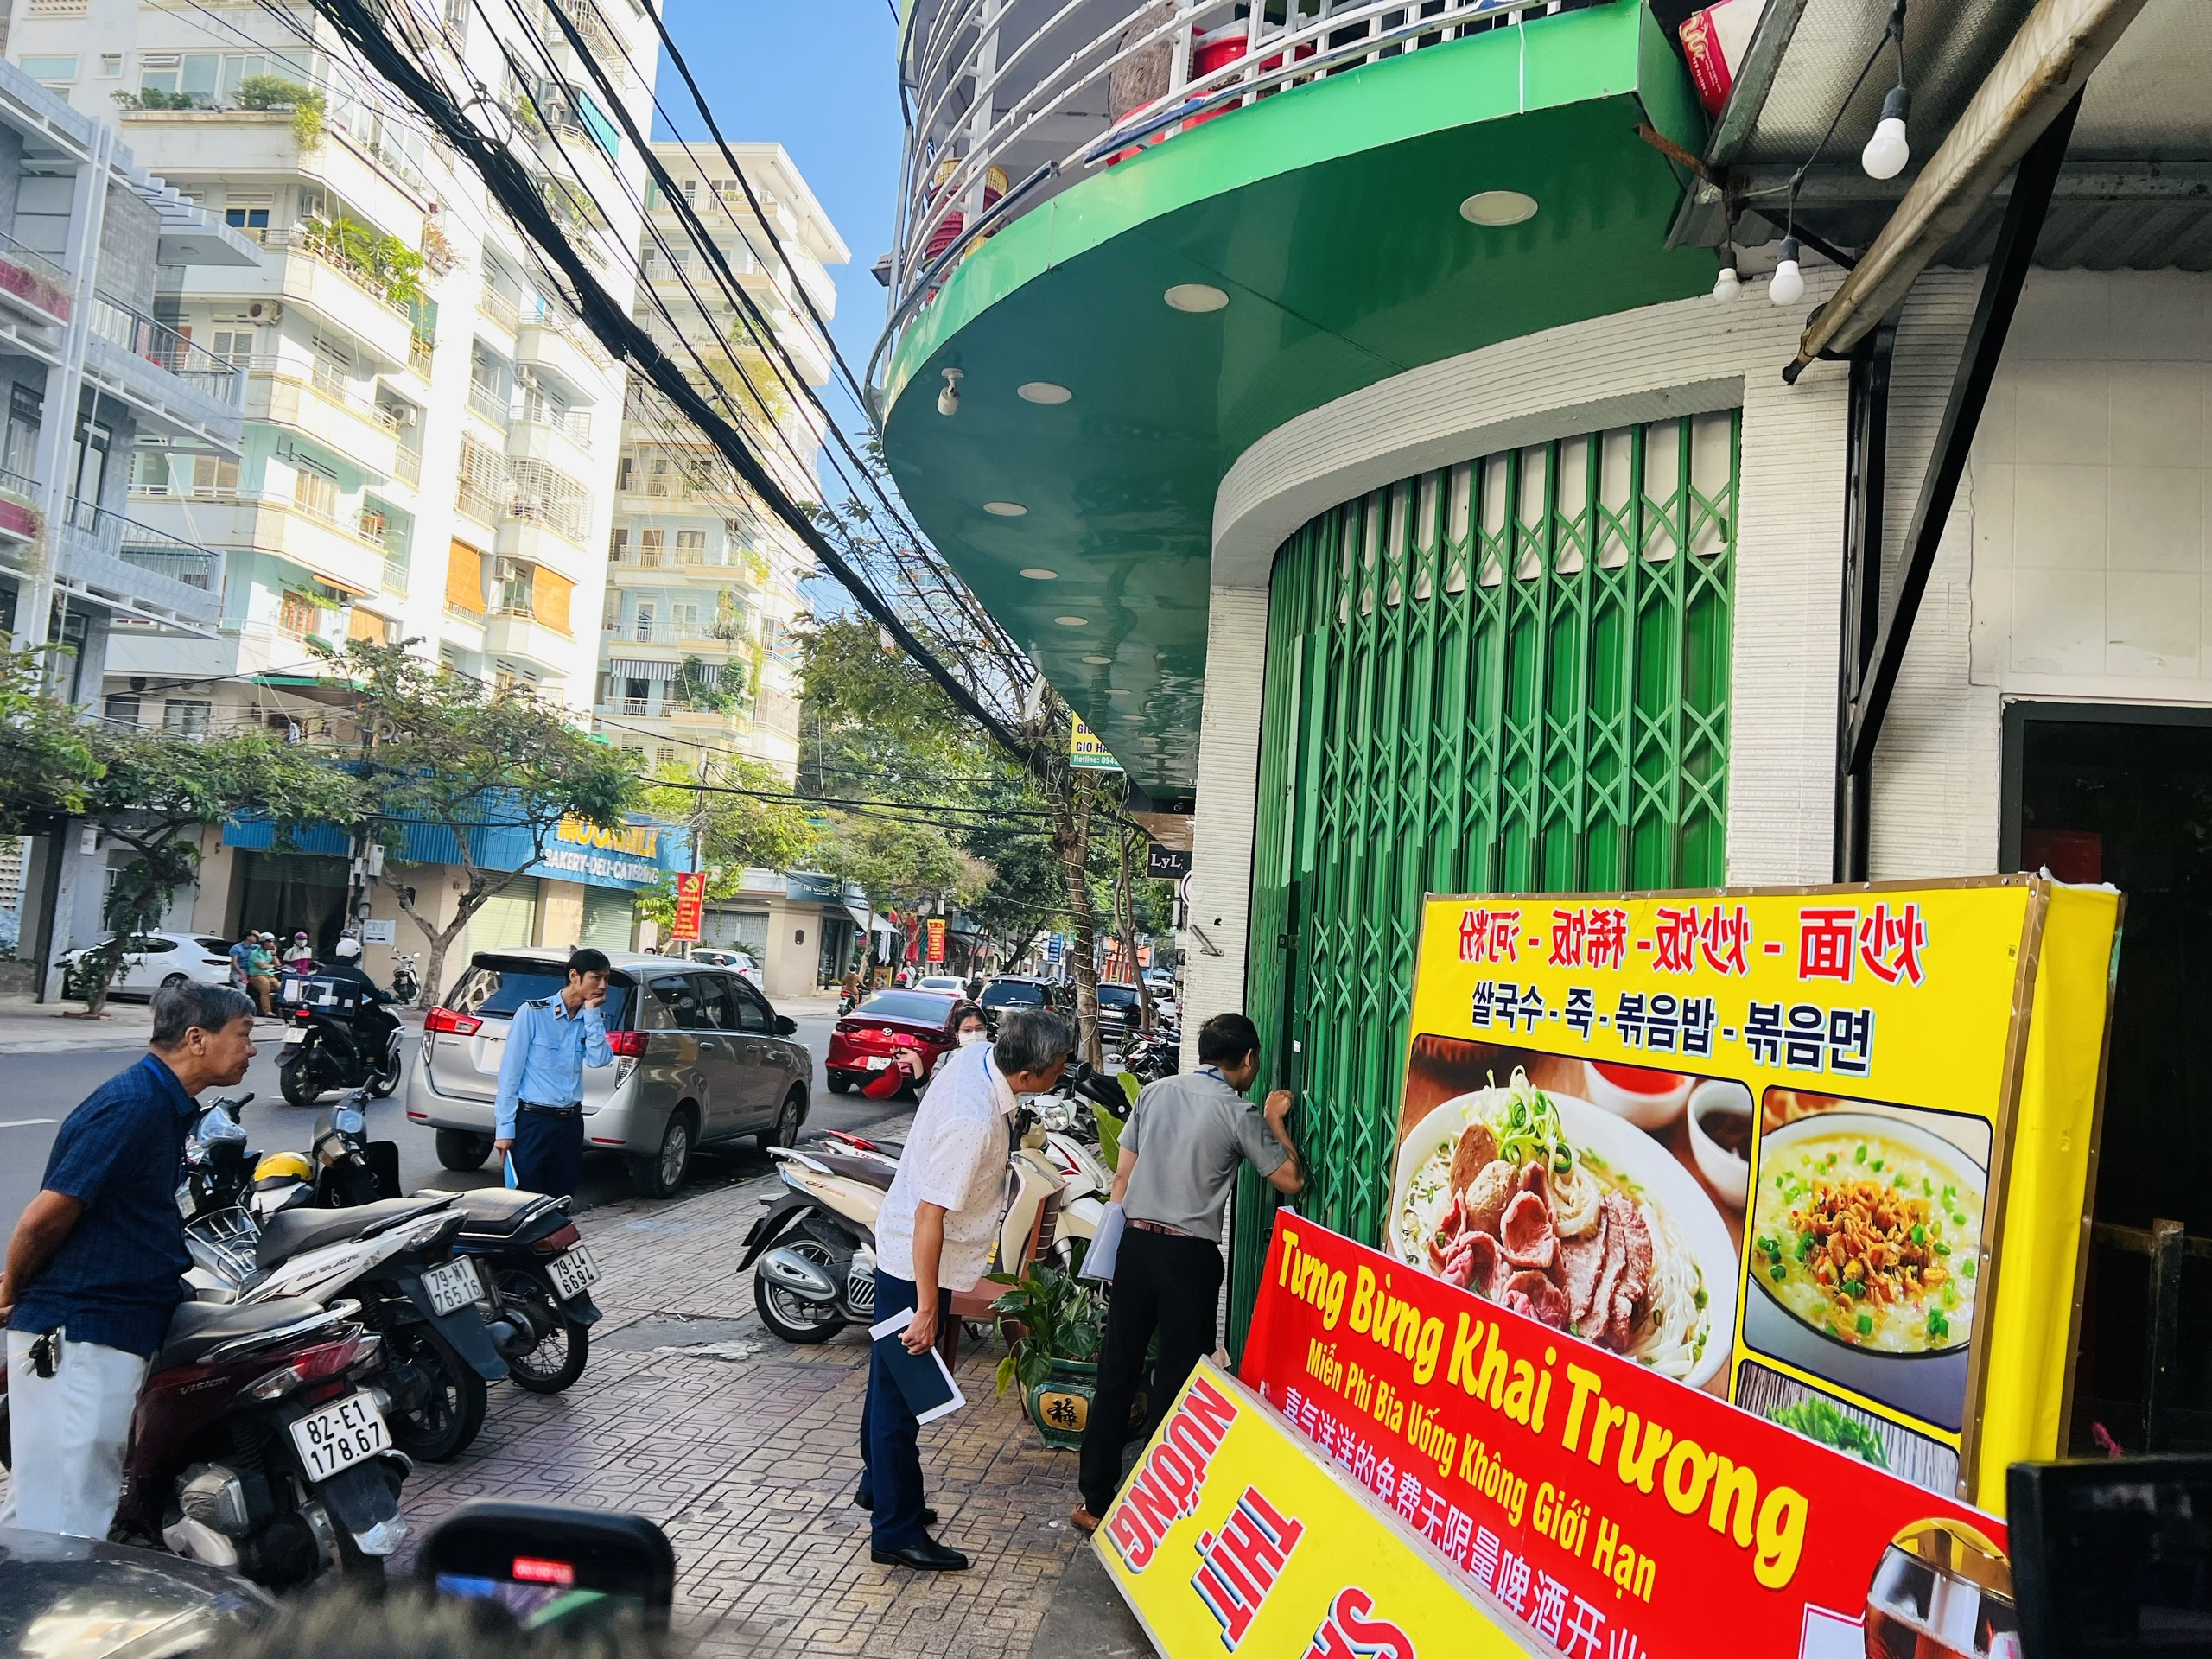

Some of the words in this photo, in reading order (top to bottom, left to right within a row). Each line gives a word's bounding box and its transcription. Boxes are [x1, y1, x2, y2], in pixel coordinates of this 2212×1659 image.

[1073, 754, 1100, 765] Hotline:
[1150, 853, 1184, 870] LyL
[1471, 982, 1544, 1032] 쌀국수
[1565, 988, 1593, 1039] 죽
[1615, 992, 1716, 1055] 볶음밥
[1744, 1001, 1872, 1073] 볶음면
[552, 1249, 586, 1279] 79-L4
[562, 1267, 594, 1294] 6694
[435, 1279, 480, 1313] 765.16
[306, 1399, 366, 1445] 82-E1
[1278, 1228, 1349, 1331] Tưng
[1349, 1264, 1446, 1386] Bừng
[1447, 1310, 1558, 1434] Khai
[1561, 1362, 1809, 1589] Trương
[310, 1421, 380, 1474] 178.67
[1306, 1337, 1343, 1393] Miễn
[1344, 1361, 1376, 1413] Phí
[1373, 1380, 1405, 1434] Bia
[1407, 1400, 1459, 1478] Uống
[1459, 1433, 1529, 1529] Không
[1532, 1481, 1592, 1559] Giới
[1592, 1516, 1656, 1605] Hạn
[1108, 1376, 1238, 1571] NƯỚNG
[1194, 1486, 1304, 1648] THỊT
